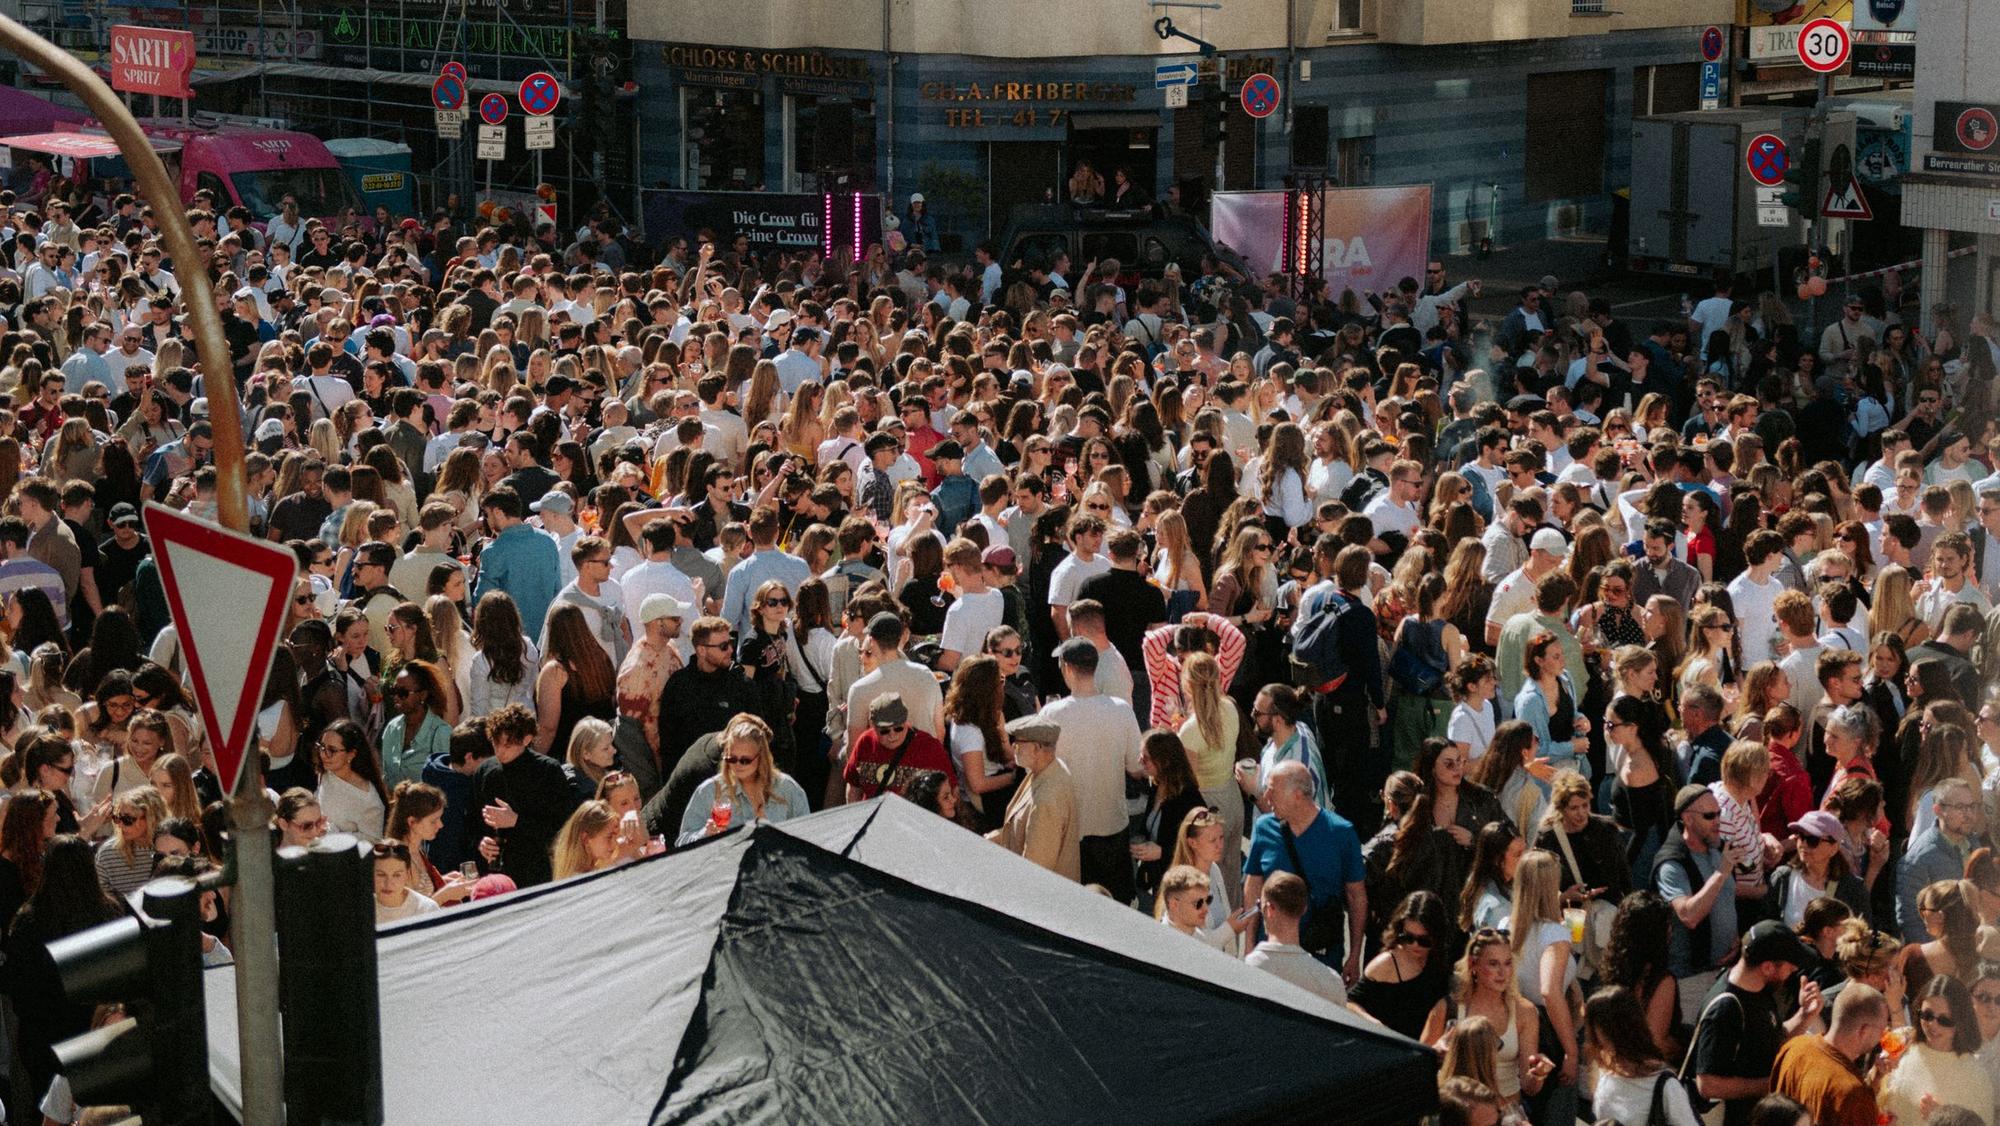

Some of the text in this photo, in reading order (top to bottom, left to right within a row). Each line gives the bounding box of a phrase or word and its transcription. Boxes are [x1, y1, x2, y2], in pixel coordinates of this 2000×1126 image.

[205, 29, 248, 50] SHOP
[1808, 33, 1839, 57] 30
[114, 35, 171, 69] SARTI
[743, 52, 757, 72] &
[123, 69, 161, 87] SPRITZ
[1704, 64, 1713, 80] P
[1930, 156, 1985, 172] Berrenrather
[733, 210, 757, 225] Die
[759, 211, 798, 226] Crow
